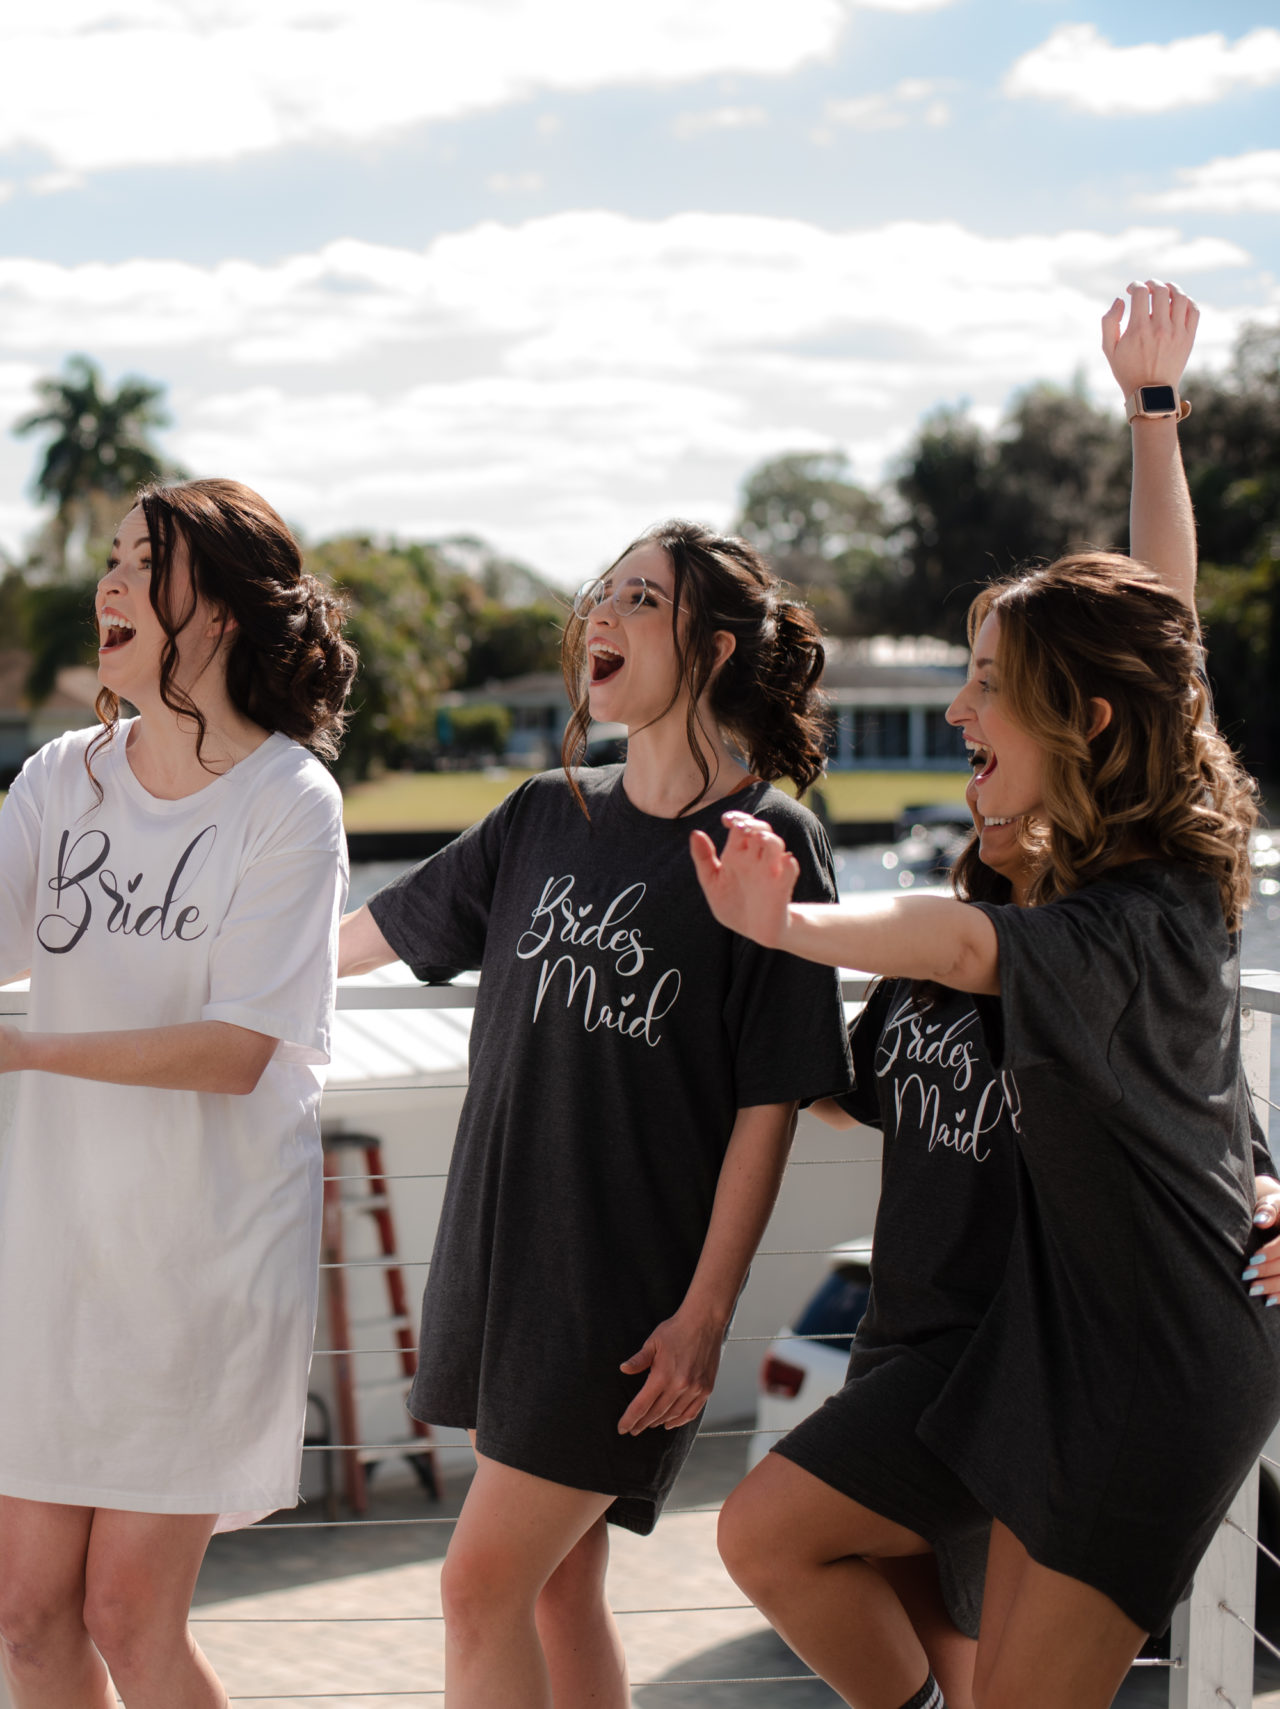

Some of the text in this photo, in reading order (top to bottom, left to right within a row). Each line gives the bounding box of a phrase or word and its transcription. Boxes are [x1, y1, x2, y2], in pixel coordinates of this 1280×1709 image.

[36, 824, 218, 954] Bride
[516, 874, 654, 976] Brides
[532, 955, 682, 1047] Maid
[894, 1073, 1005, 1162] Maid
